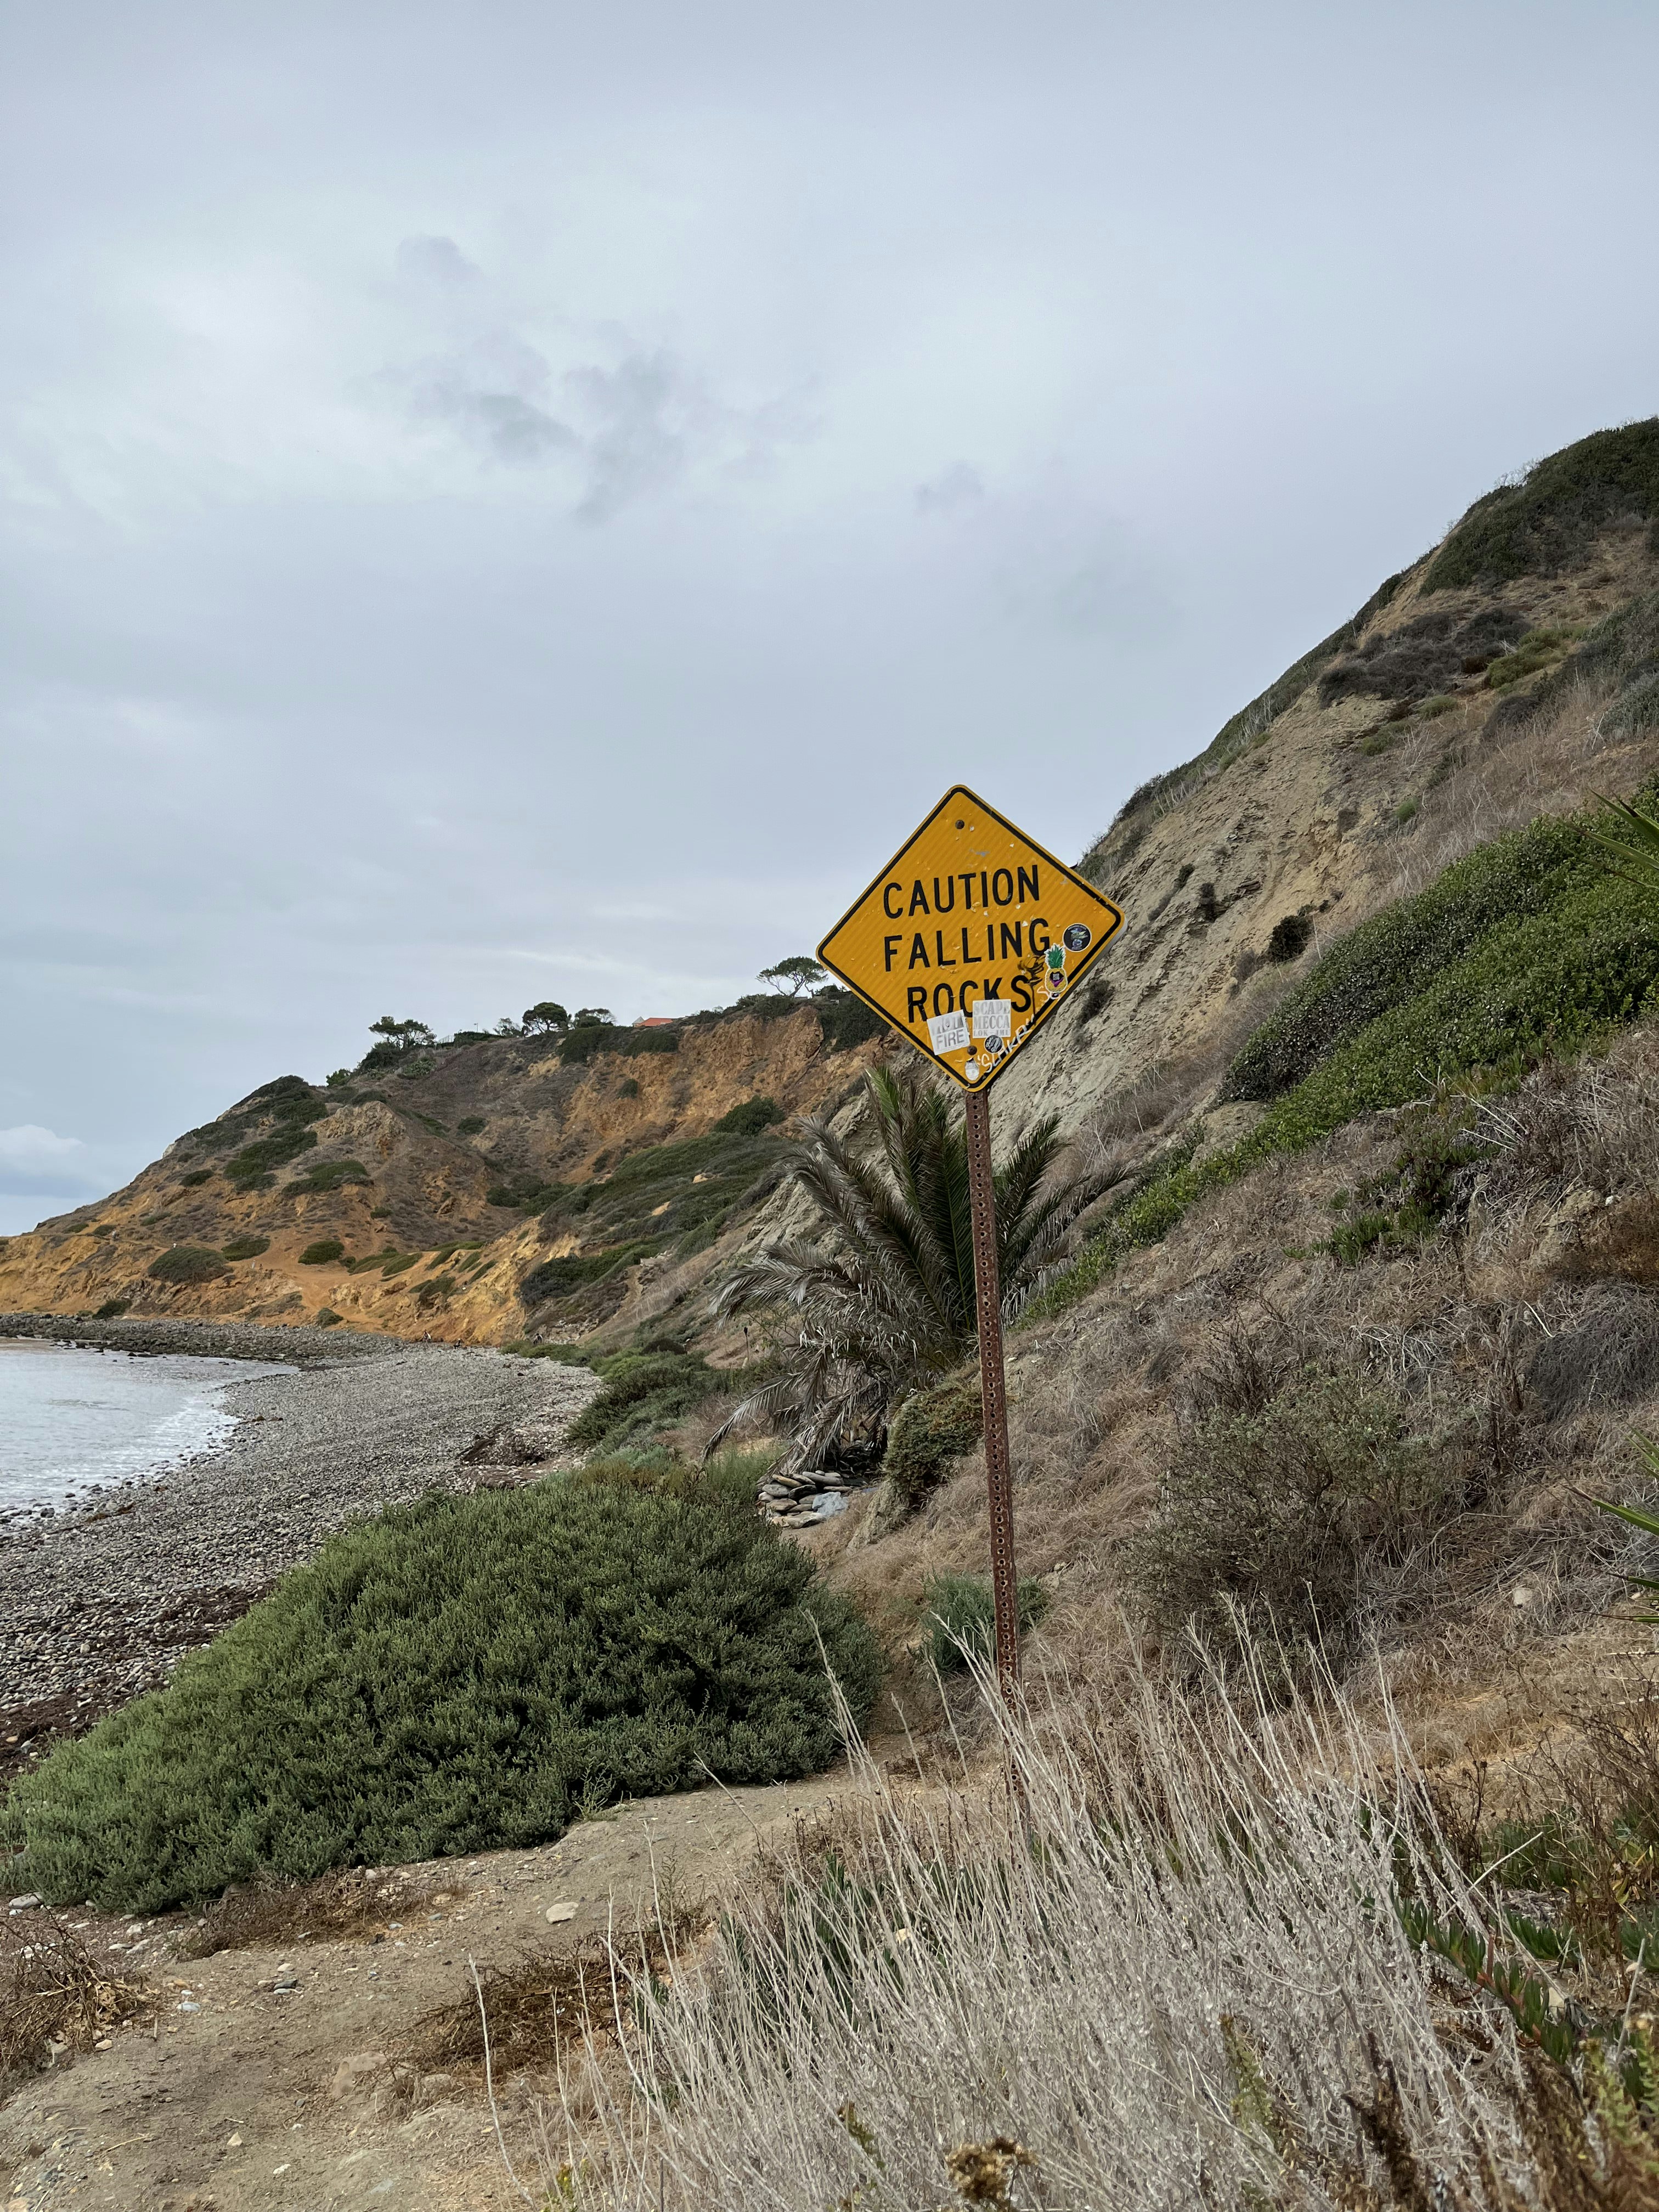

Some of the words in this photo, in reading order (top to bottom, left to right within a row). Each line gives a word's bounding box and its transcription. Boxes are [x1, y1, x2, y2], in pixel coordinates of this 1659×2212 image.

[883, 865, 1040, 919] CAUTION
[884, 918, 1050, 972] FALLING
[907, 975, 1031, 1023] ROCKS
[973, 1001, 1011, 1015] SCAPE
[973, 1015, 1010, 1029] MECCA
[936, 1029, 965, 1050] FIRE
